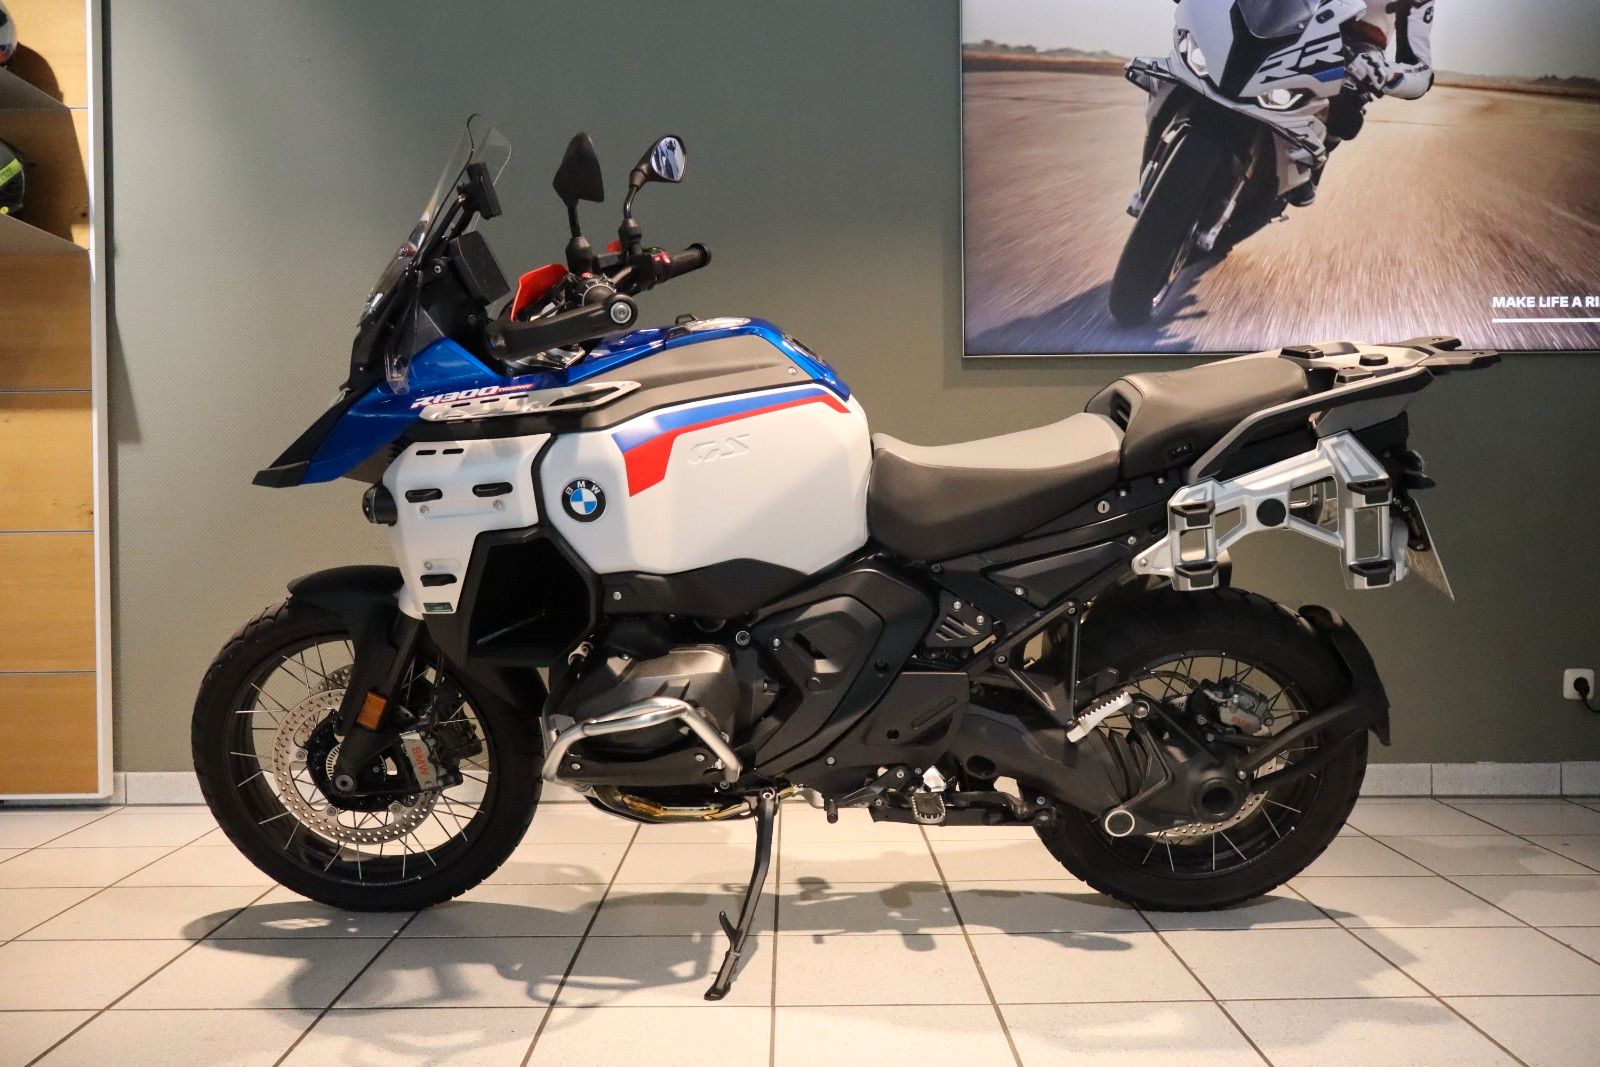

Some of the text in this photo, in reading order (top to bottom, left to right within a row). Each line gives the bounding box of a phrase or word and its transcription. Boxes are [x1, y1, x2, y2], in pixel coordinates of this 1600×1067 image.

[1492, 296, 1536, 308] MAKE
[1538, 296, 1569, 308] LIFE
[1571, 296, 1583, 308] A
[565, 480, 601, 496] BMW
[412, 746, 429, 775] BMW
